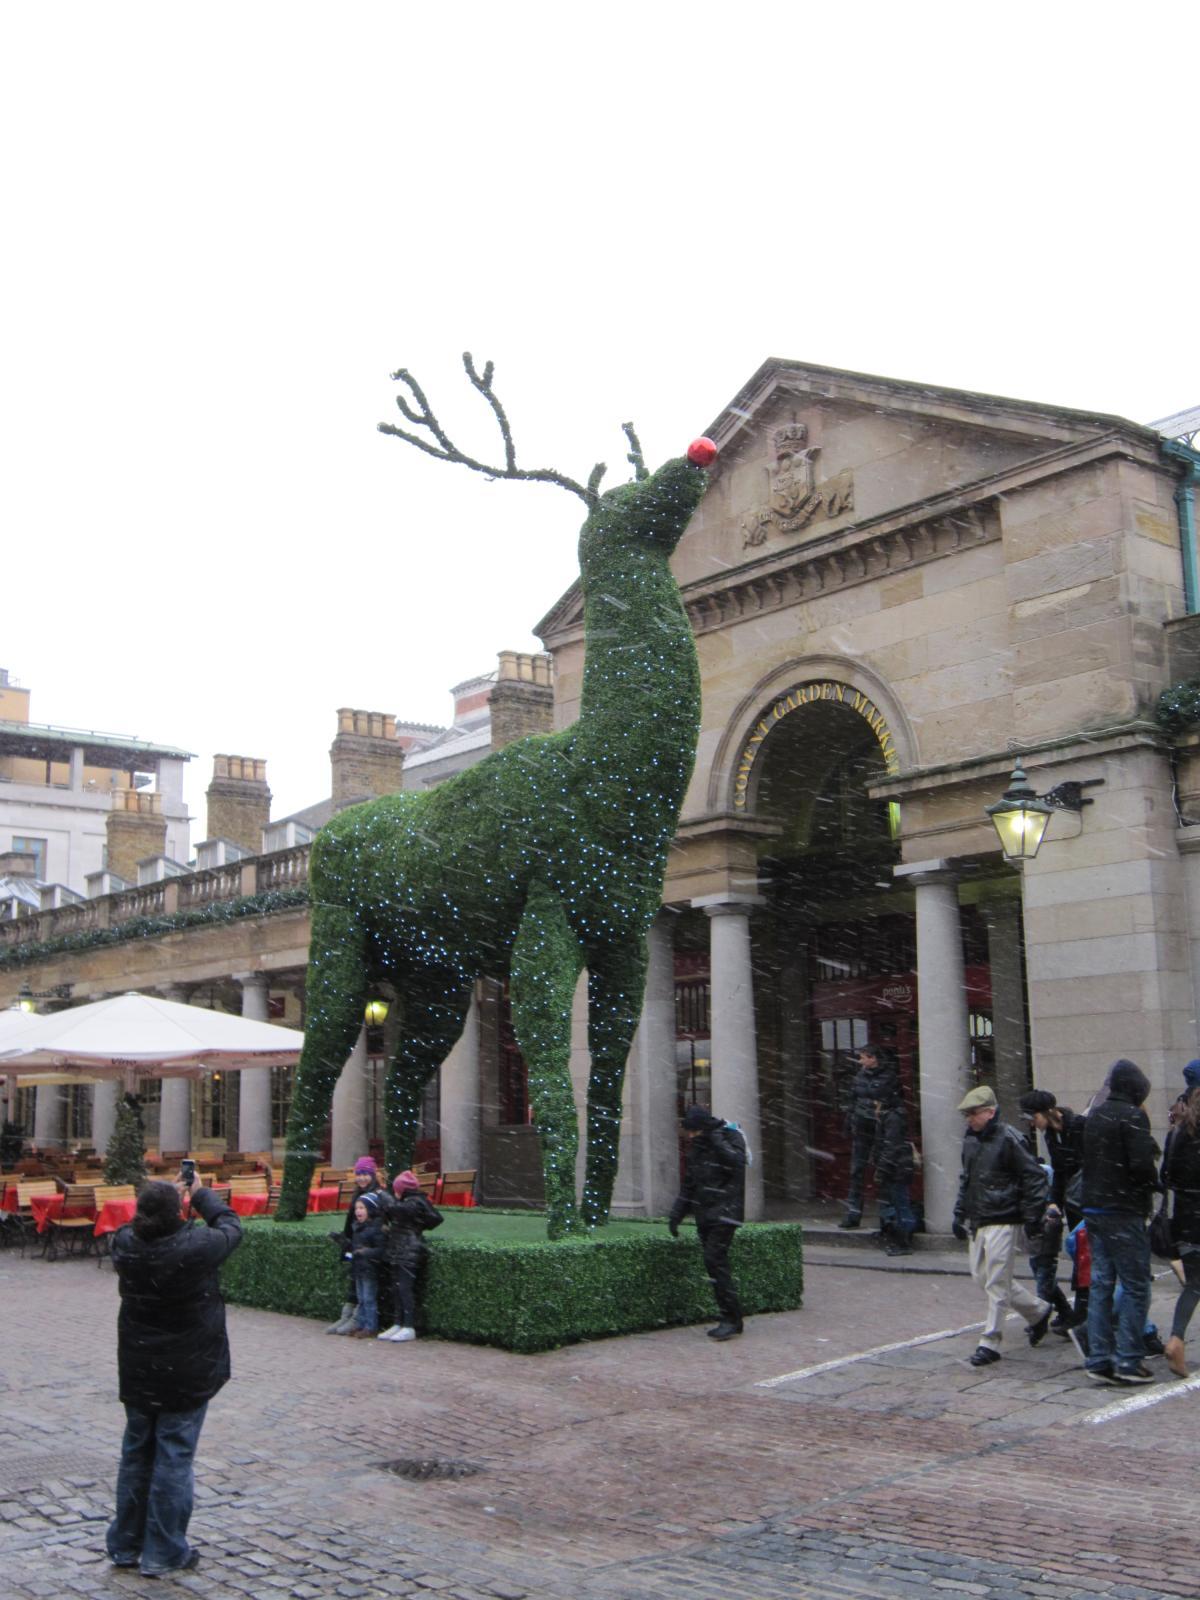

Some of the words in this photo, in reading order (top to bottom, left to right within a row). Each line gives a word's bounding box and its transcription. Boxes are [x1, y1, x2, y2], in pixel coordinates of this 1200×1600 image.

[735, 719, 770, 807] COVENT
[773, 683, 848, 720] GARDEN
[849, 691, 899, 777] MARKET
